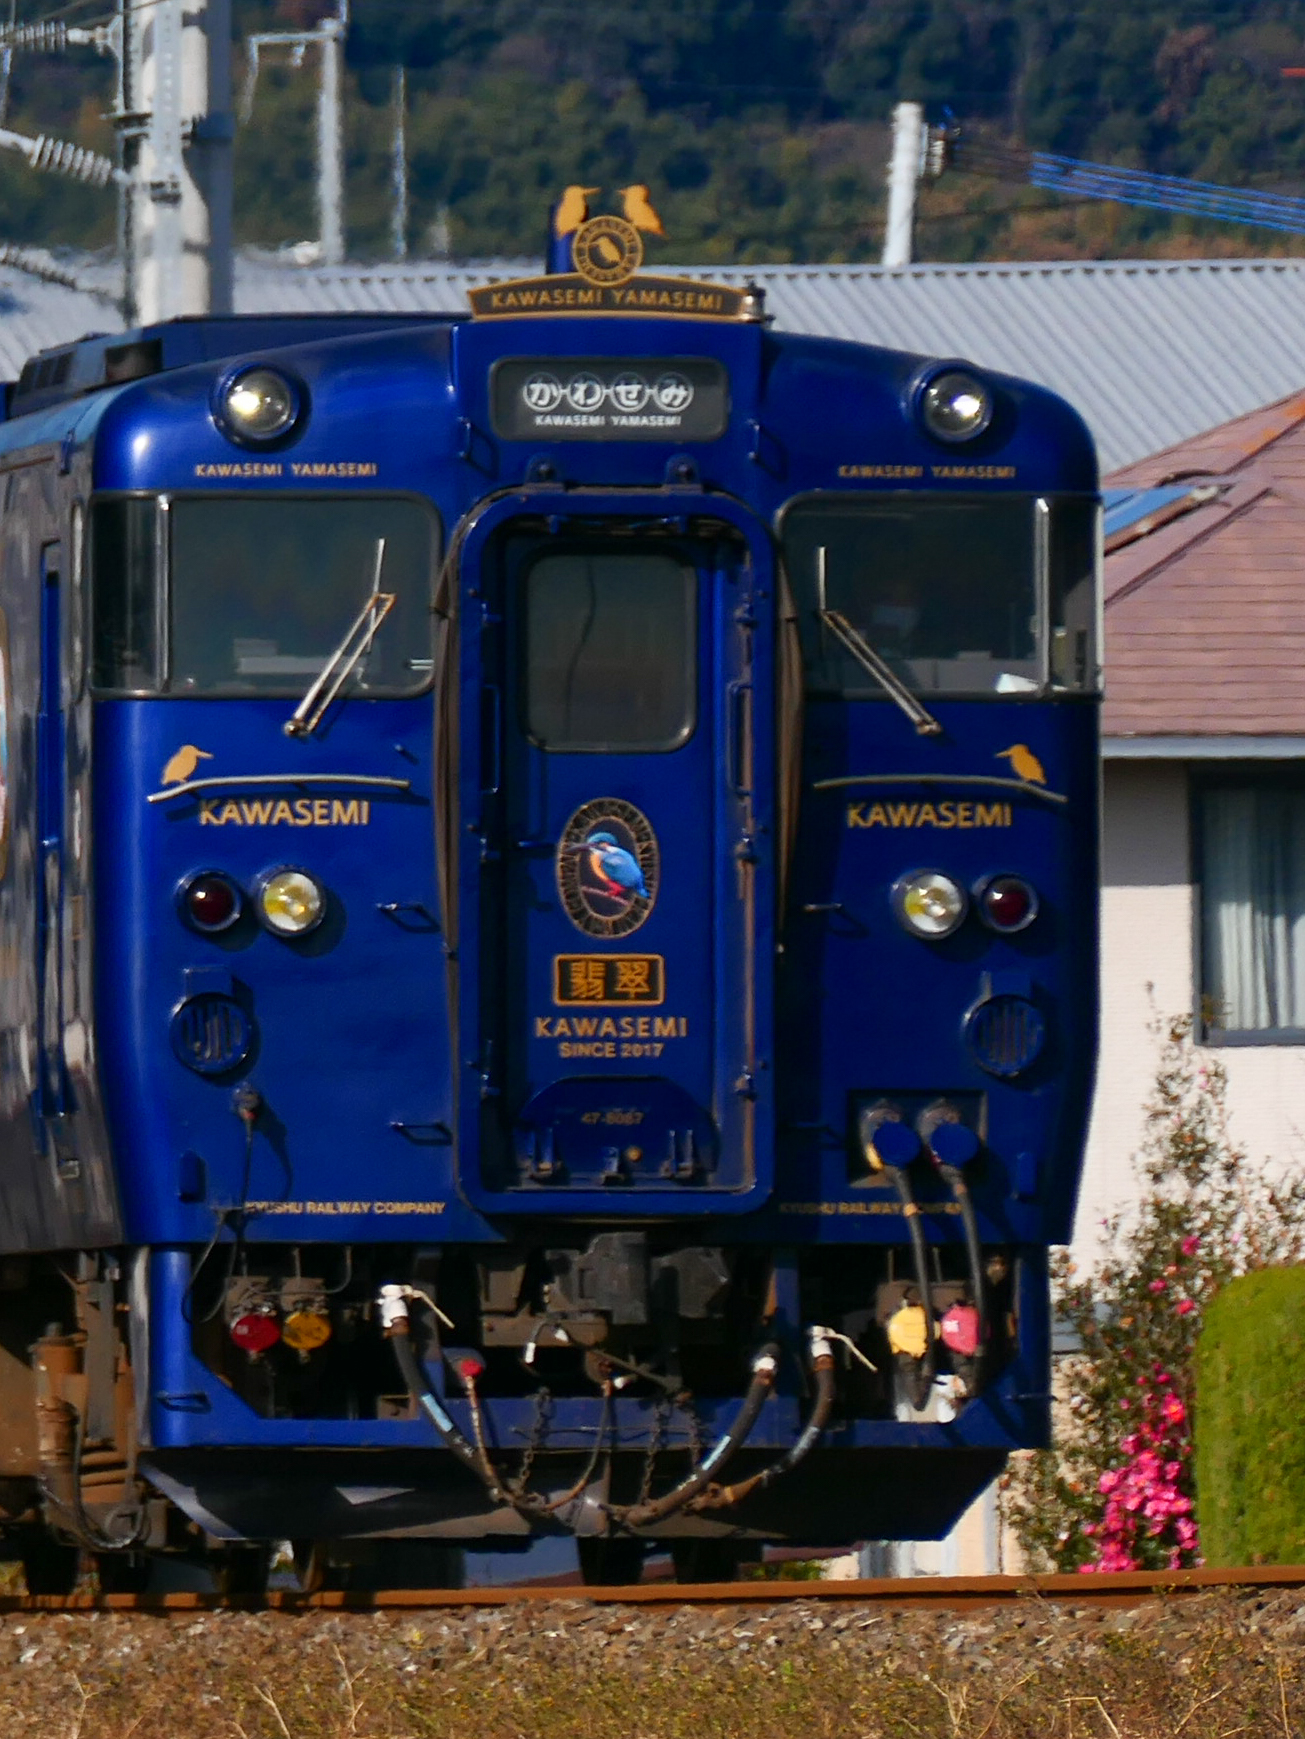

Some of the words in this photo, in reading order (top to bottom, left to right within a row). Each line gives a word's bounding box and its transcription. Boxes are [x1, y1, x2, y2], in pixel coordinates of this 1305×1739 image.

[492, 288, 602, 308] KAWASEMI
[611, 289, 723, 311] YAMASEMI
[526, 376, 691, 411] かわせみ
[534, 415, 605, 426] KAWASEMI
[612, 416, 681, 427] YAMASEMI
[195, 463, 282, 477] KAWASEMI
[291, 463, 377, 477] YAMASEMI
[839, 466, 922, 478] KAWASEMI
[932, 466, 1015, 478] YAMASEMI
[199, 799, 370, 826] KAWASEMI
[847, 802, 1012, 829] KAWASEMI
[570, 961, 651, 999] 翡翠
[534, 1016, 688, 1037] KAWASEMI
[559, 1041, 617, 1058] SINCE
[620, 1042, 665, 1058] 2017
[306, 1201, 371, 1215] RAILWAY
[374, 1201, 446, 1215] COMPANY
[838, 1202, 903, 1216] RAILWAY
